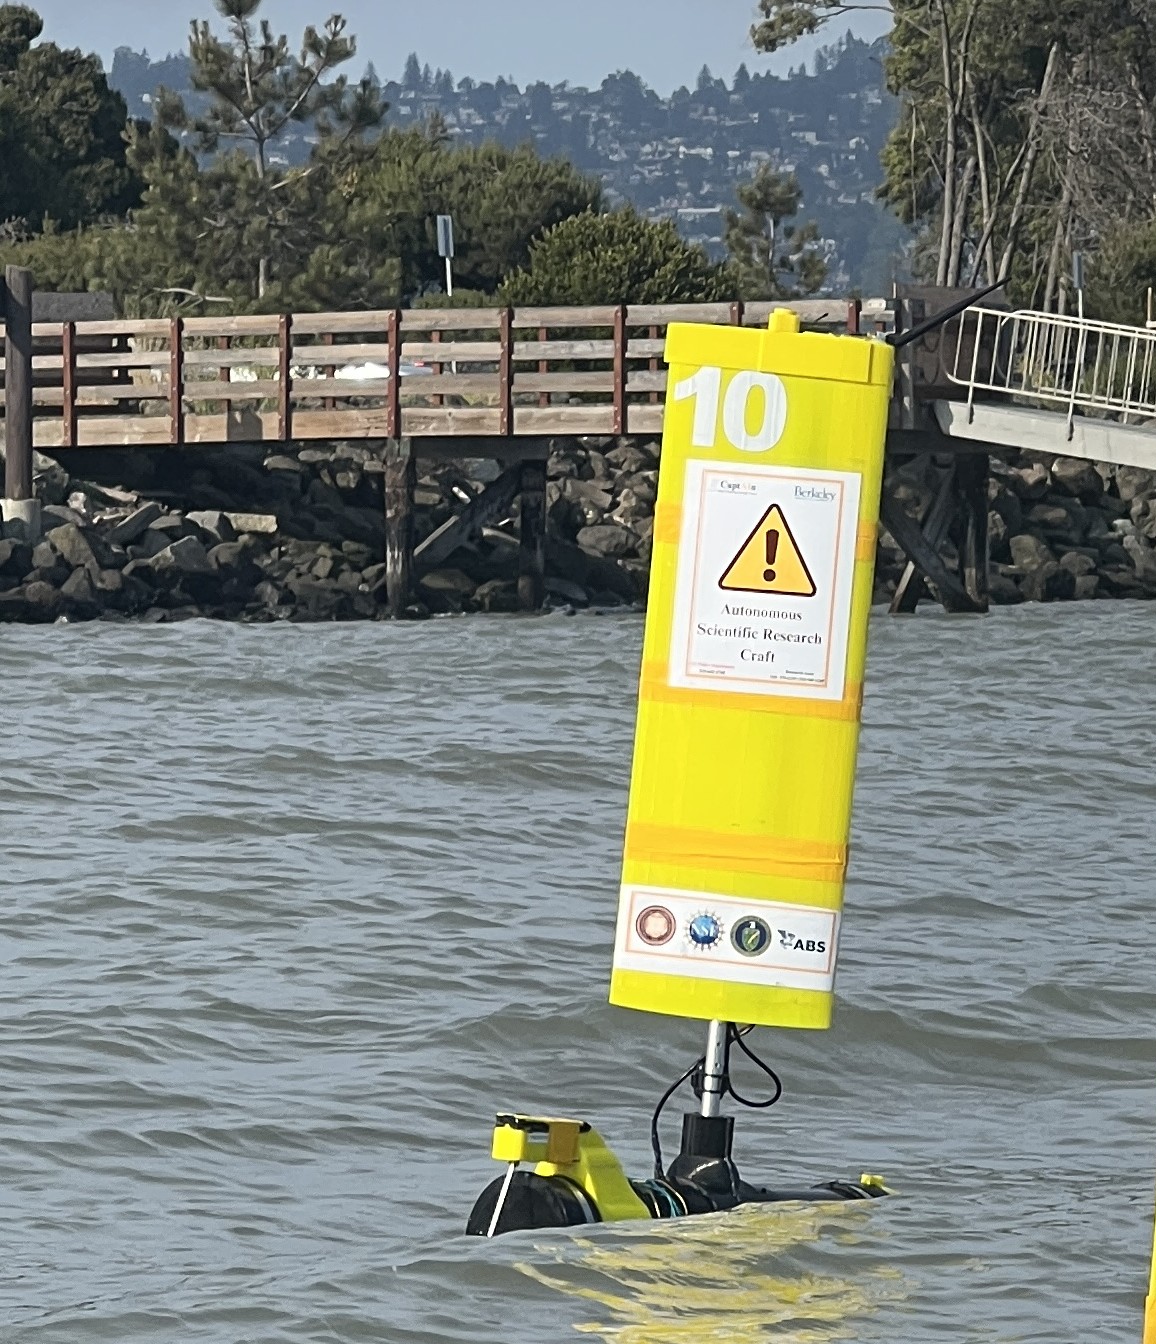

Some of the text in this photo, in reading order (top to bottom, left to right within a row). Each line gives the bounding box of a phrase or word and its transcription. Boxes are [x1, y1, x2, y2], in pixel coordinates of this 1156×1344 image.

[674, 366, 787, 452] 10
[794, 486, 836, 501] Berkeley
[721, 604, 802, 621] Autonomous
[697, 623, 822, 644] Scientific Research
[741, 648, 775, 663] Craft
[793, 939, 826, 953] ABS
